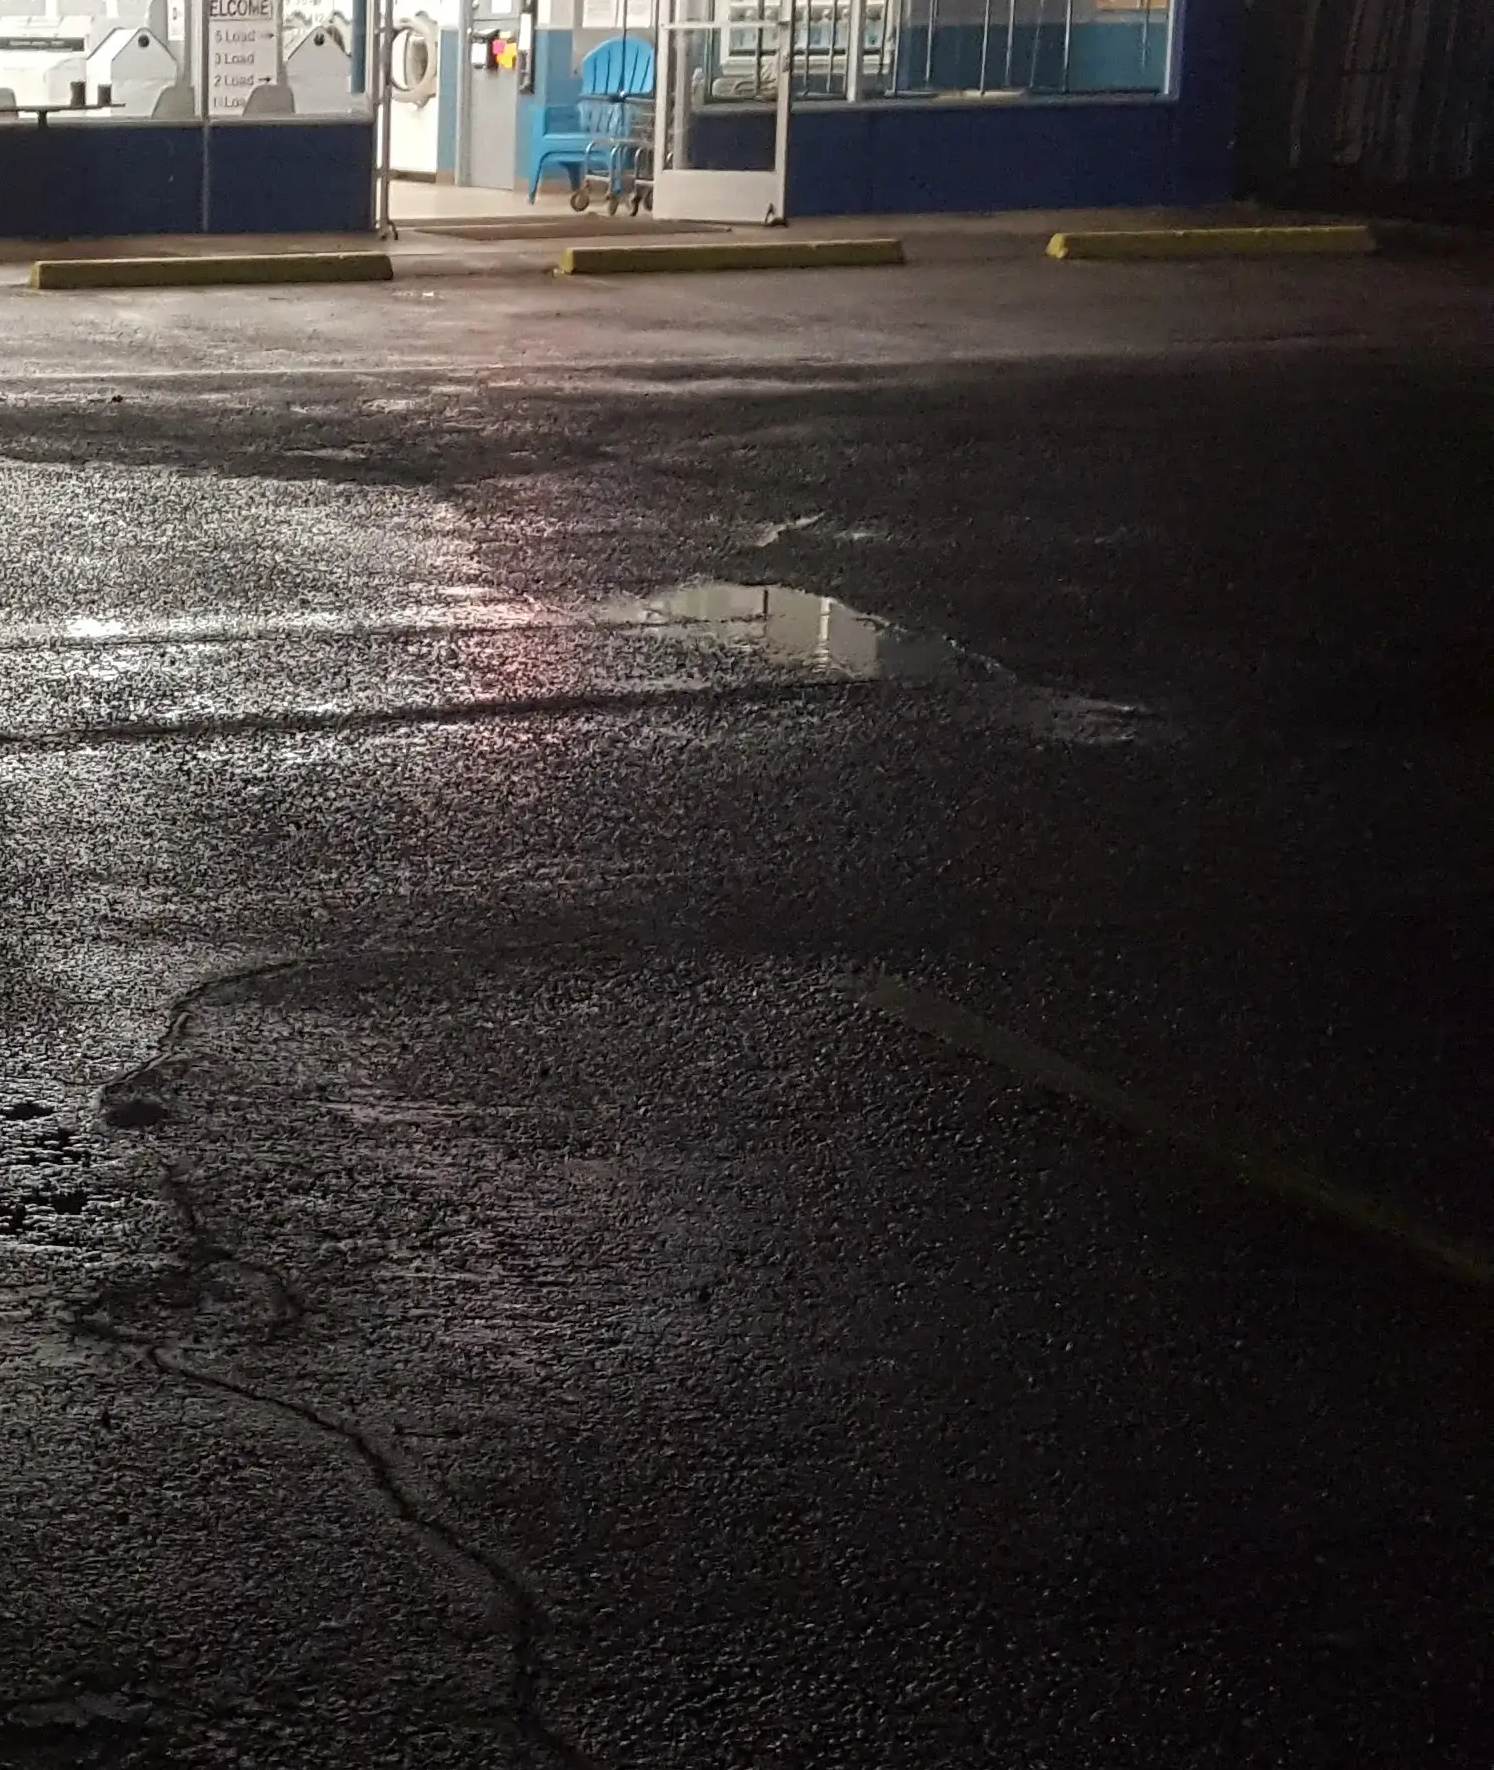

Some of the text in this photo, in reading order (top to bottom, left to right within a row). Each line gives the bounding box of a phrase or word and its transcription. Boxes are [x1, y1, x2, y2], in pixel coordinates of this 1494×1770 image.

[226, 28, 255, 42] Load
[225, 52, 255, 65] Load
[214, 75, 255, 87] 2 Load
[225, 96, 247, 109] Loa
